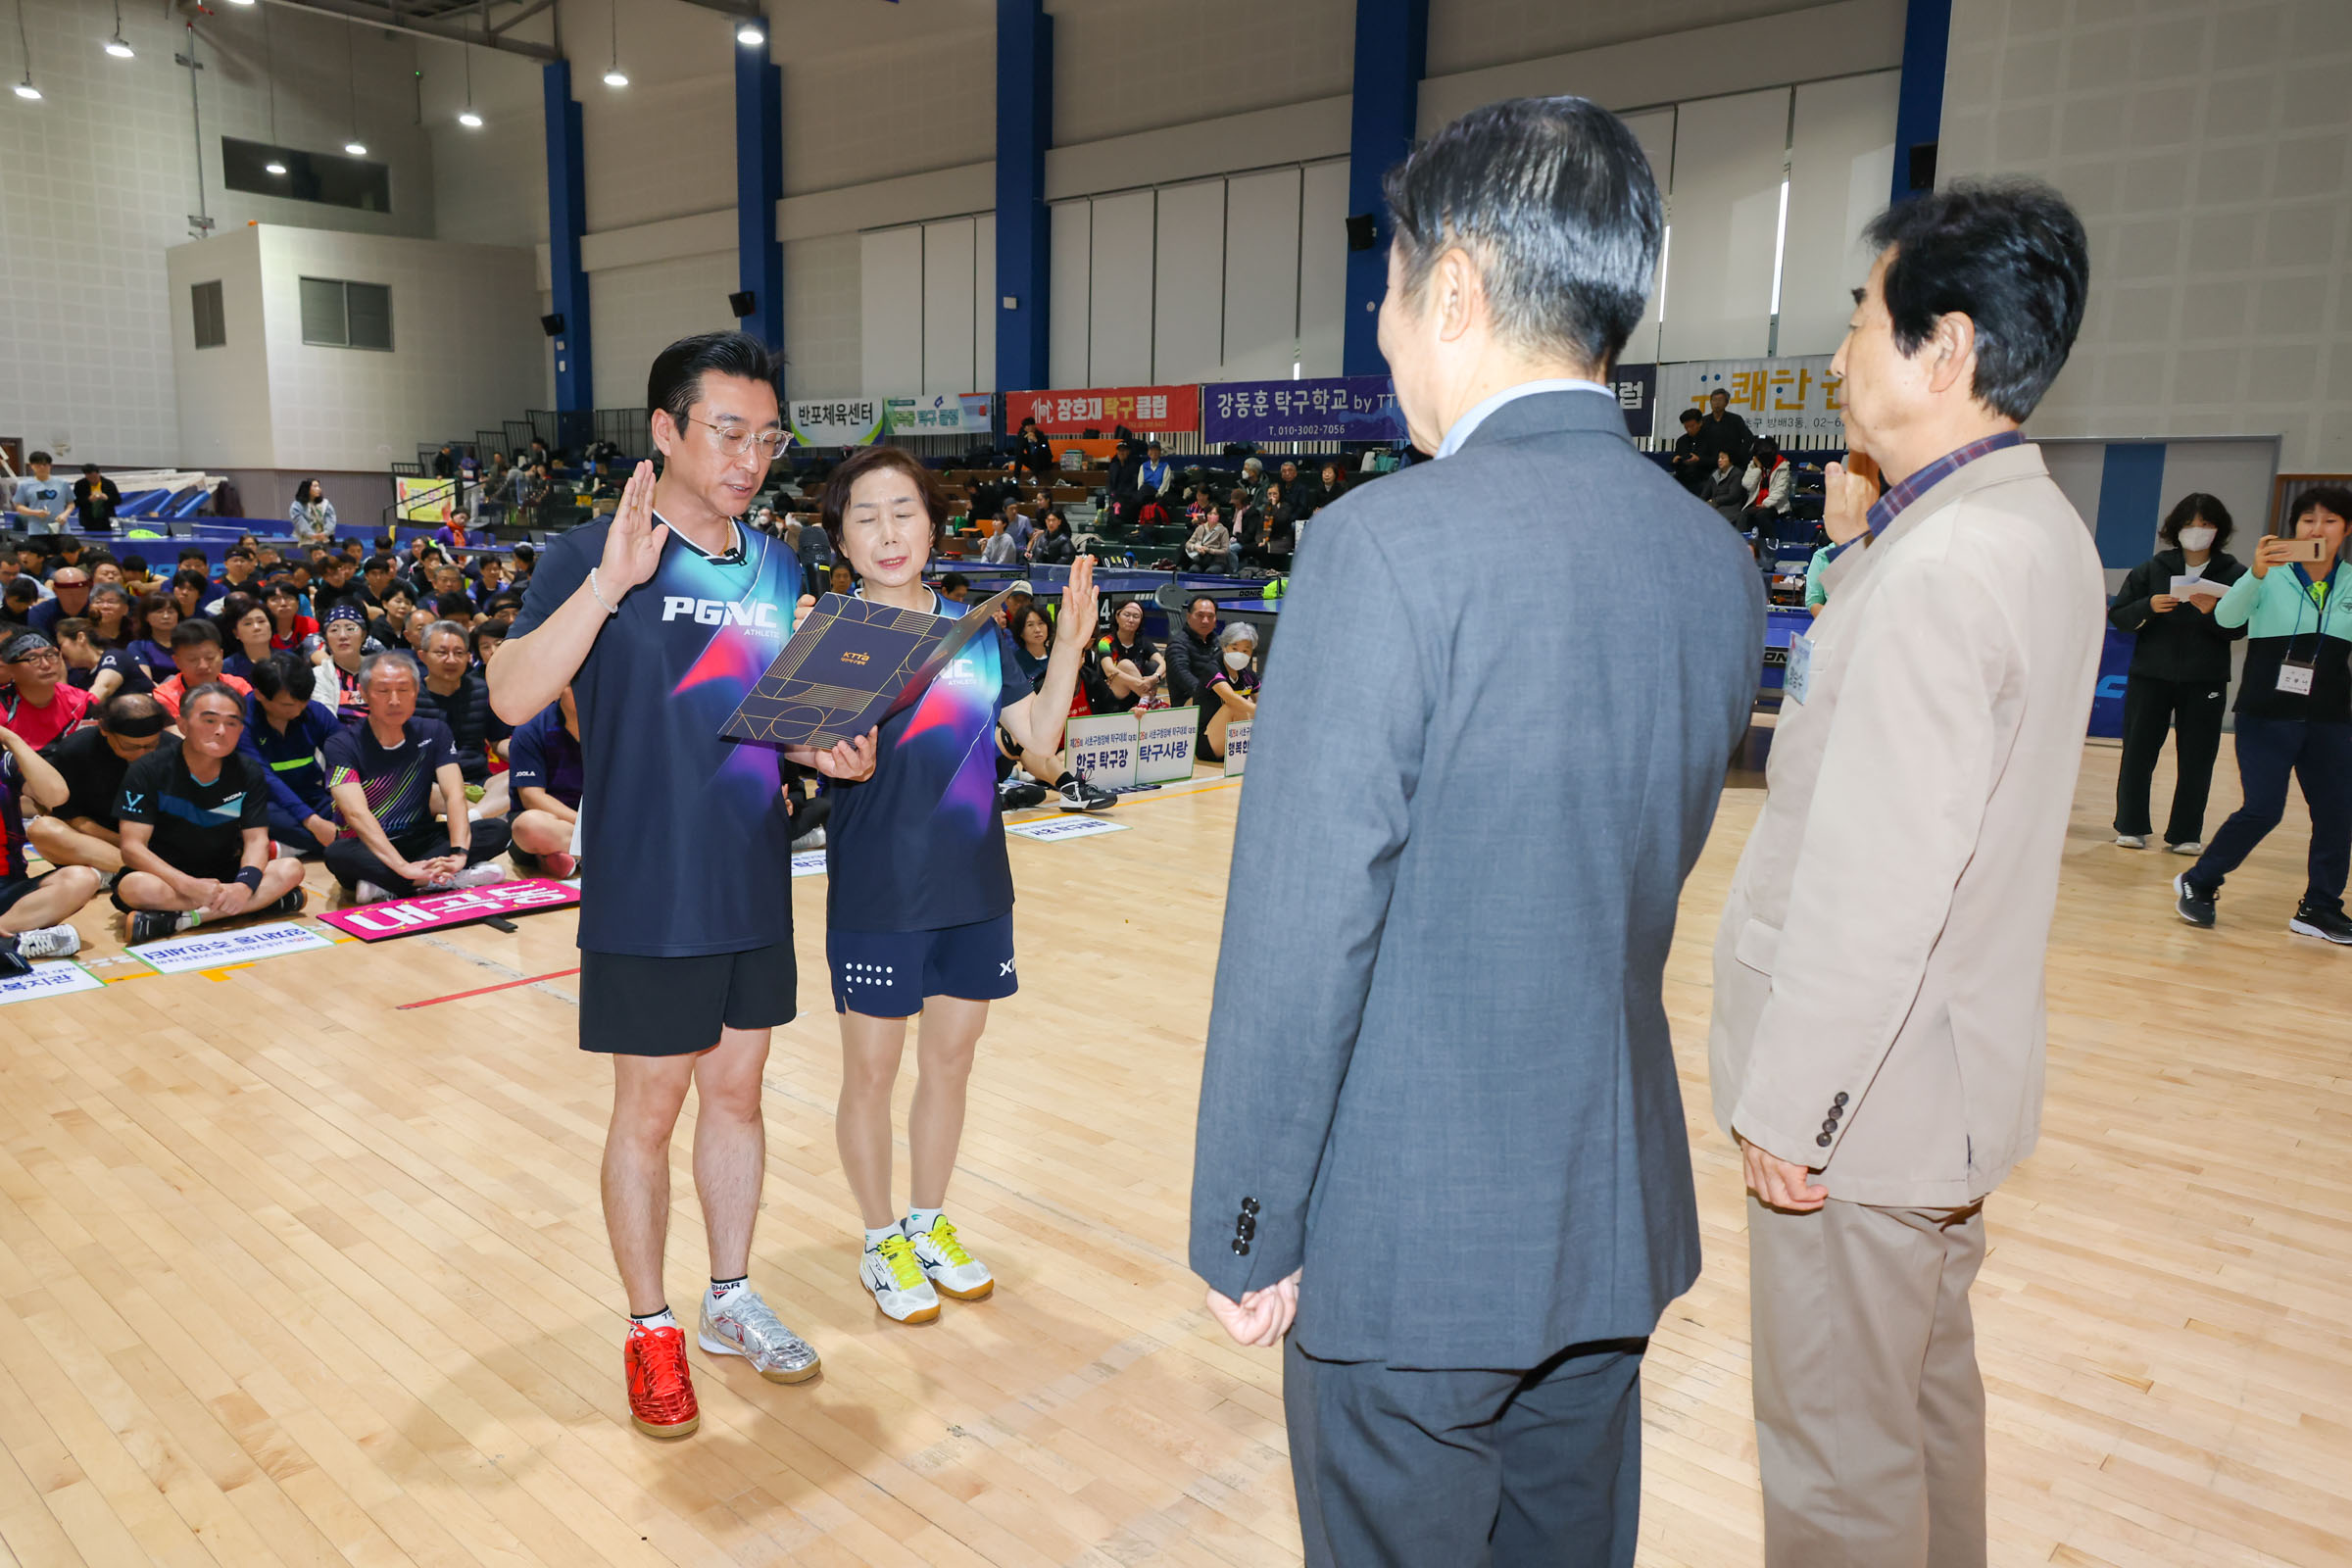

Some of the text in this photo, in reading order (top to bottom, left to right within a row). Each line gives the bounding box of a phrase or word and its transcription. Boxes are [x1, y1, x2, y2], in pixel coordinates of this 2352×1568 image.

[798, 401, 873, 427] 반포체육센터
[1217, 389, 1270, 418] 강동훈
[1275, 388, 1349, 416] 탁구학교
[1353, 395, 1373, 413] by
[1813, 416, 1844, 428] 02-6
[662, 596, 778, 628] PGNC
[1076, 749, 1129, 772] 한국 탁구장
[1139, 740, 1189, 763] 탁구사랑
[343, 881, 568, 931] 내곡동
[0, 973, 74, 994] 복지관
